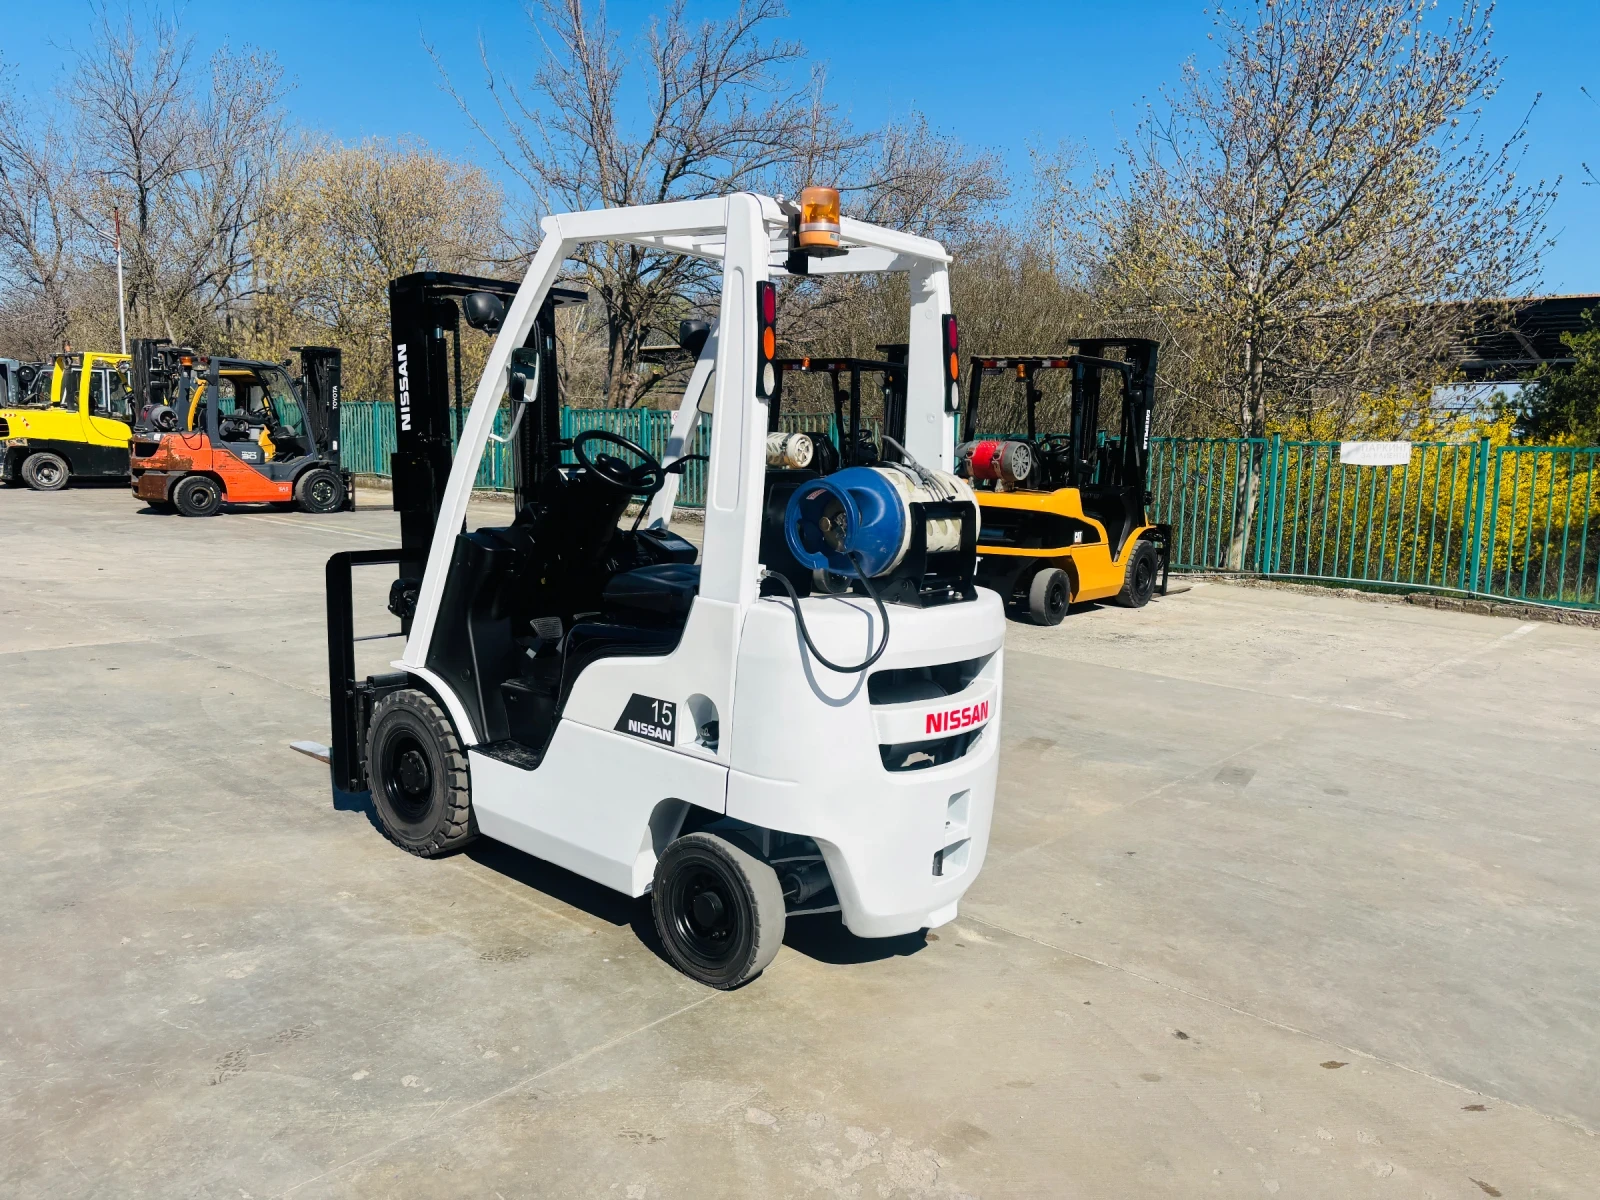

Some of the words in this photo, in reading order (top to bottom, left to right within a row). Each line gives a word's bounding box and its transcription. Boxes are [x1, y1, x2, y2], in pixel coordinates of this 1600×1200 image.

[397, 343, 412, 431] NISSAN
[1361, 443, 1408, 452] ПАРКИНГ
[651, 700, 673, 726] 15
[925, 700, 989, 734] NISSAN
[628, 719, 672, 742] NISSAN
